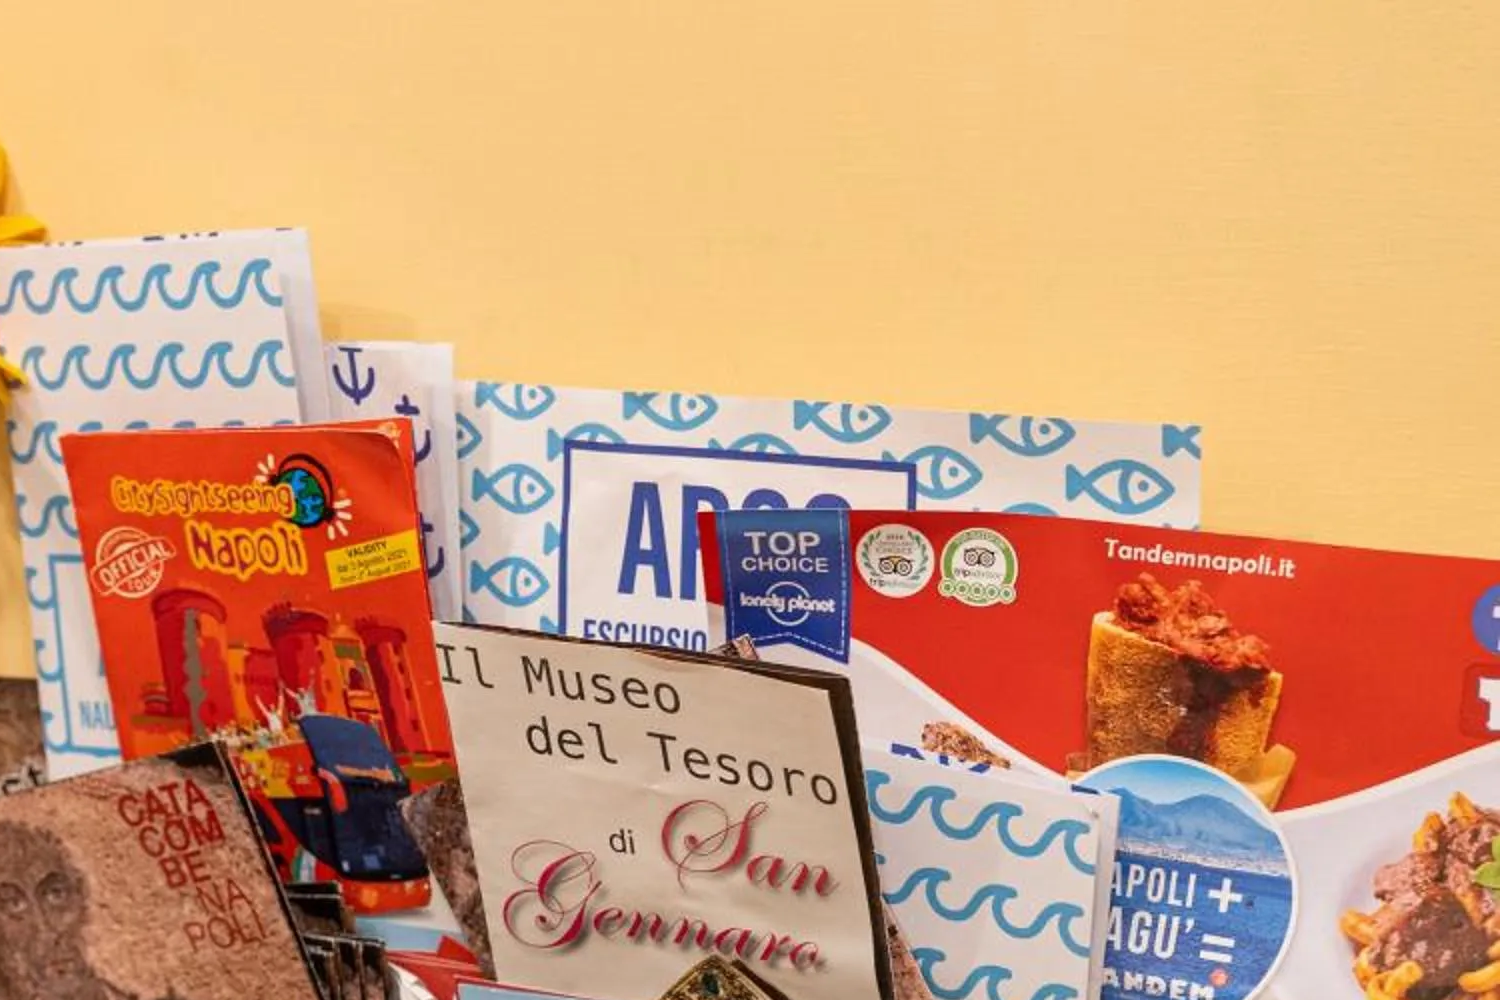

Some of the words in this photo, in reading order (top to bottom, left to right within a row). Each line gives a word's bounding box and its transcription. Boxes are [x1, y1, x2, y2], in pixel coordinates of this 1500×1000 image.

[97, 534, 177, 593] OFFICIAL
[185, 521, 308, 581] Napoli
[741, 555, 830, 574] CHOICE
[743, 531, 821, 556] TOP
[1103, 537, 1297, 580] Tandemnapoli.it
[738, 591, 786, 613] lonely
[786, 593, 836, 616] planet
[435, 643, 495, 689] Il
[521, 654, 682, 715] Museo
[526, 715, 619, 765] del
[646, 731, 838, 805] Tesoro
[117, 778, 215, 828] CATA
[138, 814, 227, 859] COM
[608, 829, 636, 855] di
[661, 799, 841, 899] San
[158, 852, 213, 890] BE
[196, 880, 253, 915] NA
[502, 839, 826, 972] Gennaro
[182, 910, 268, 954] POLI
